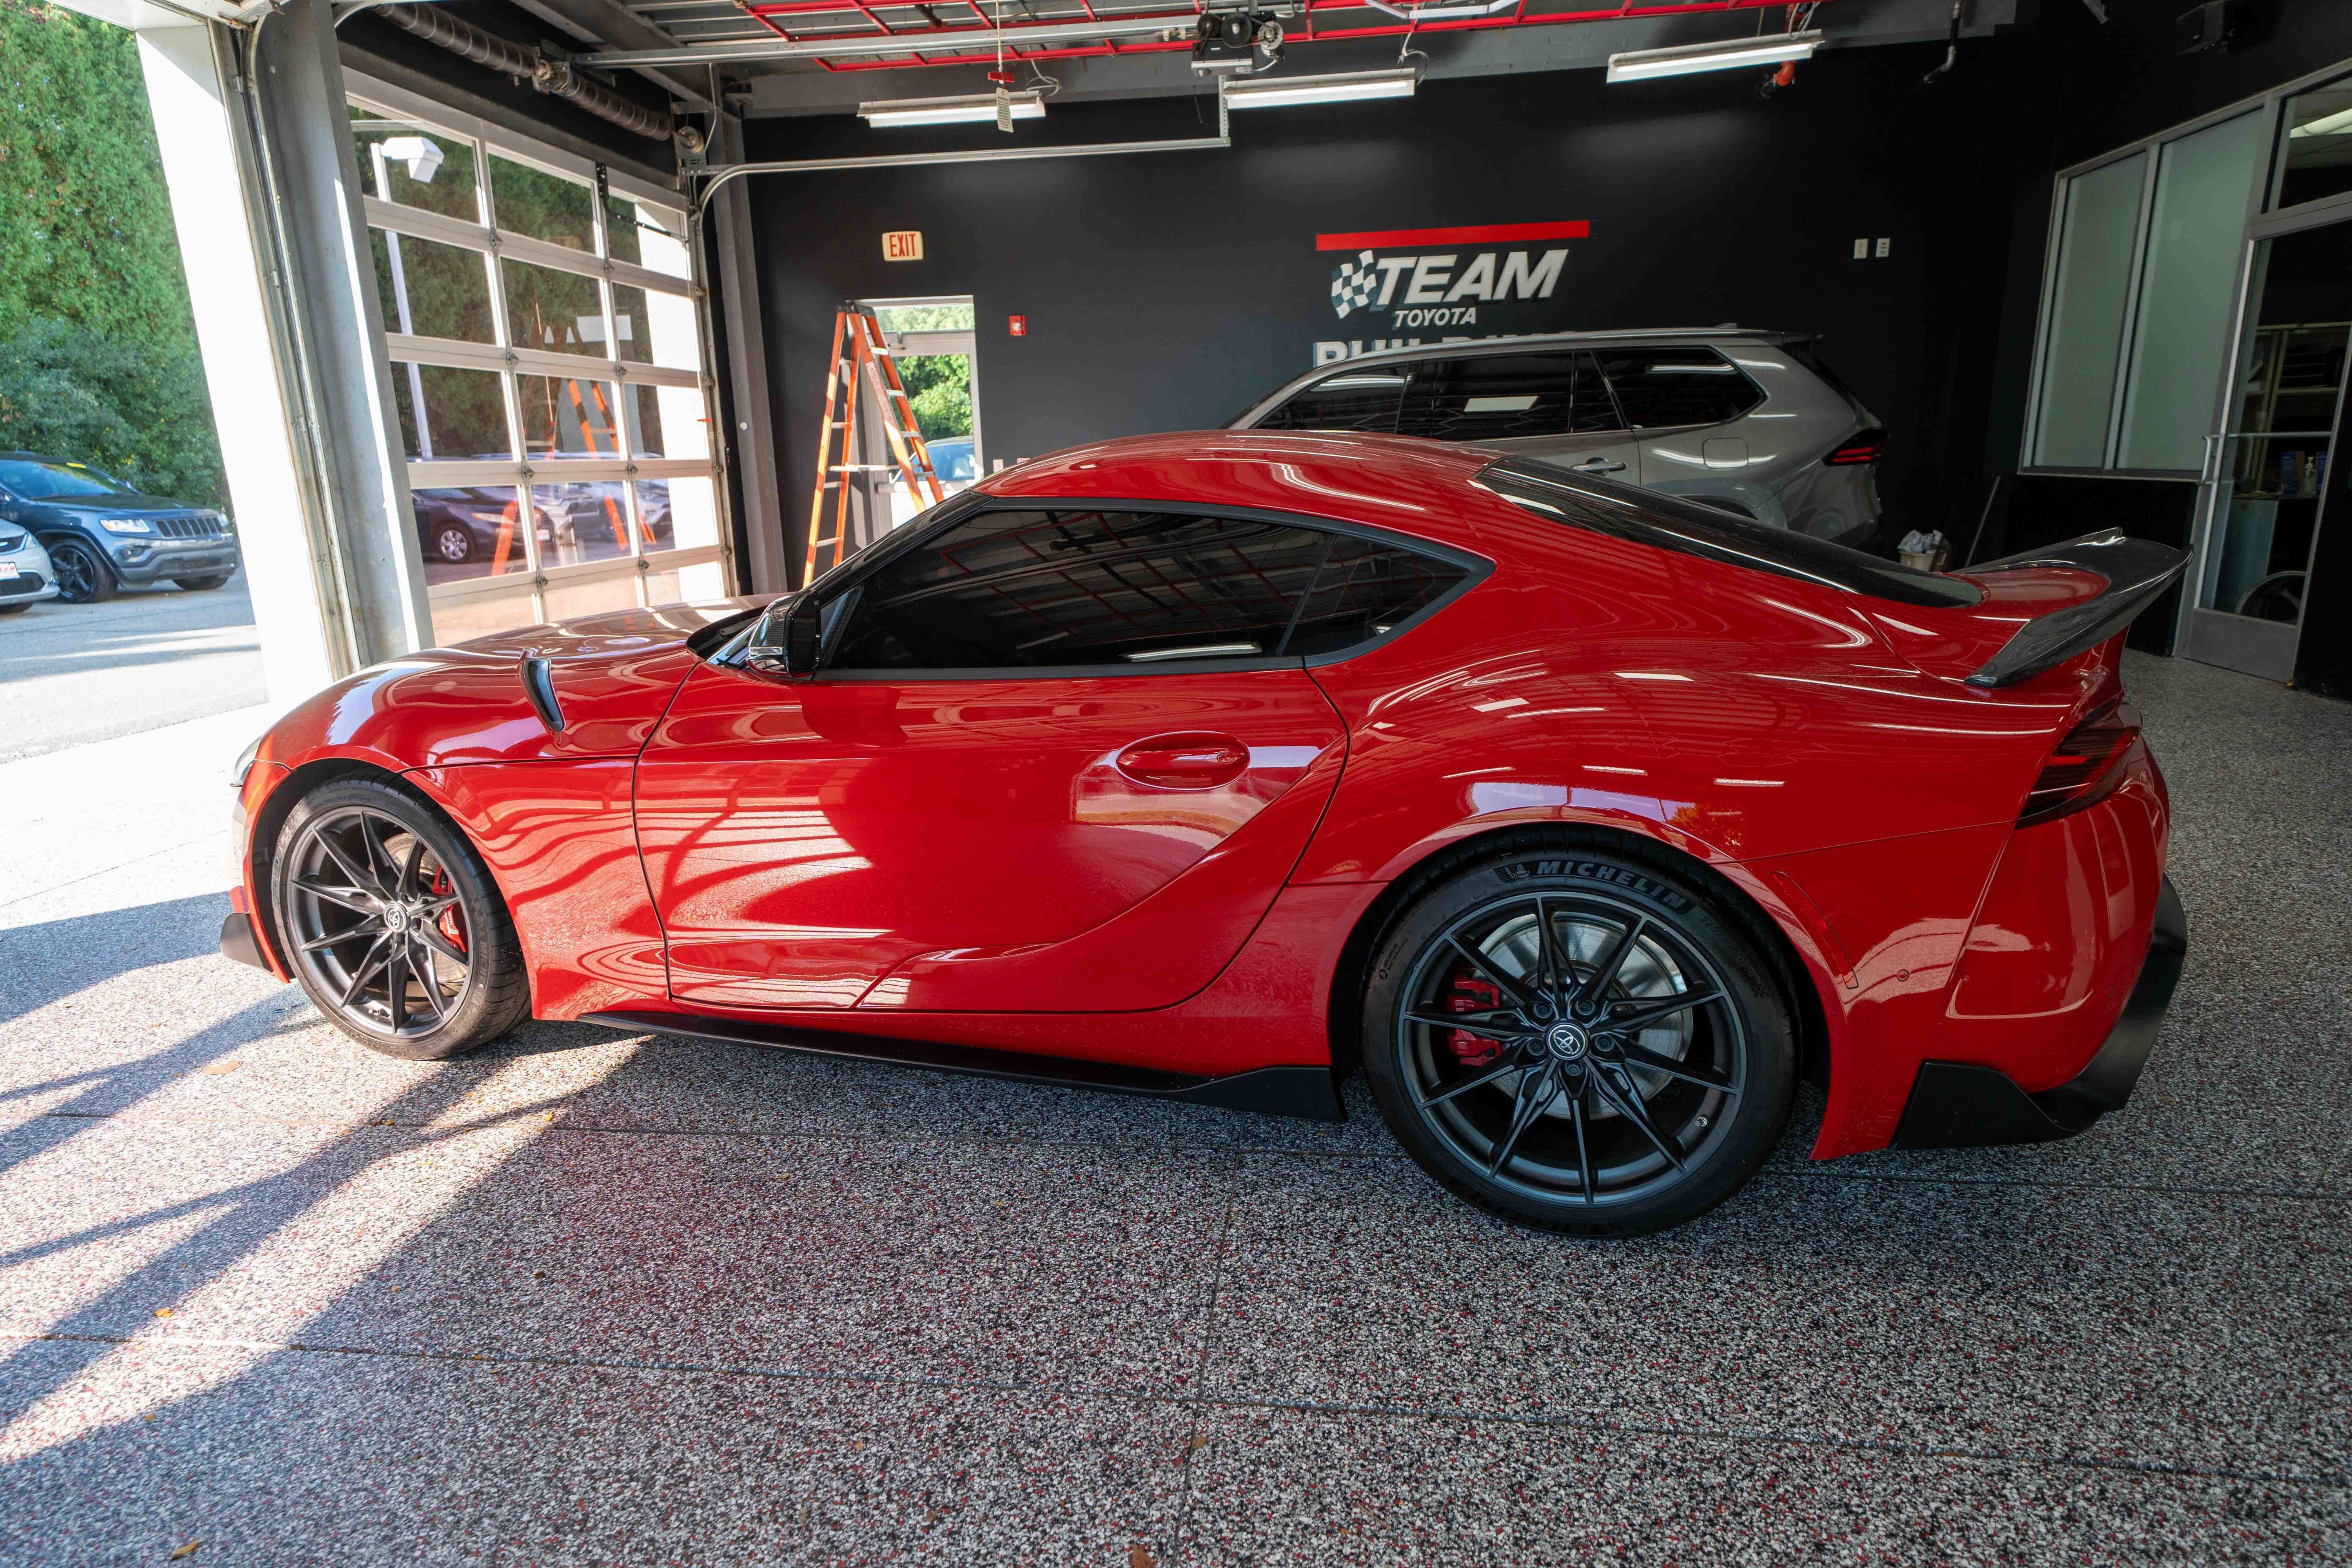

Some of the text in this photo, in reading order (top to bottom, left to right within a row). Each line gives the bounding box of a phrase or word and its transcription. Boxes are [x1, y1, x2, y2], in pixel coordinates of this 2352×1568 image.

[889, 234, 915, 257] EXIT
[1374, 248, 1570, 306] TEAM
[1393, 307, 1477, 328] TOYOTA
[1537, 860, 1687, 909] MICHELIN
[1383, 942, 1398, 967] MICHELIN
